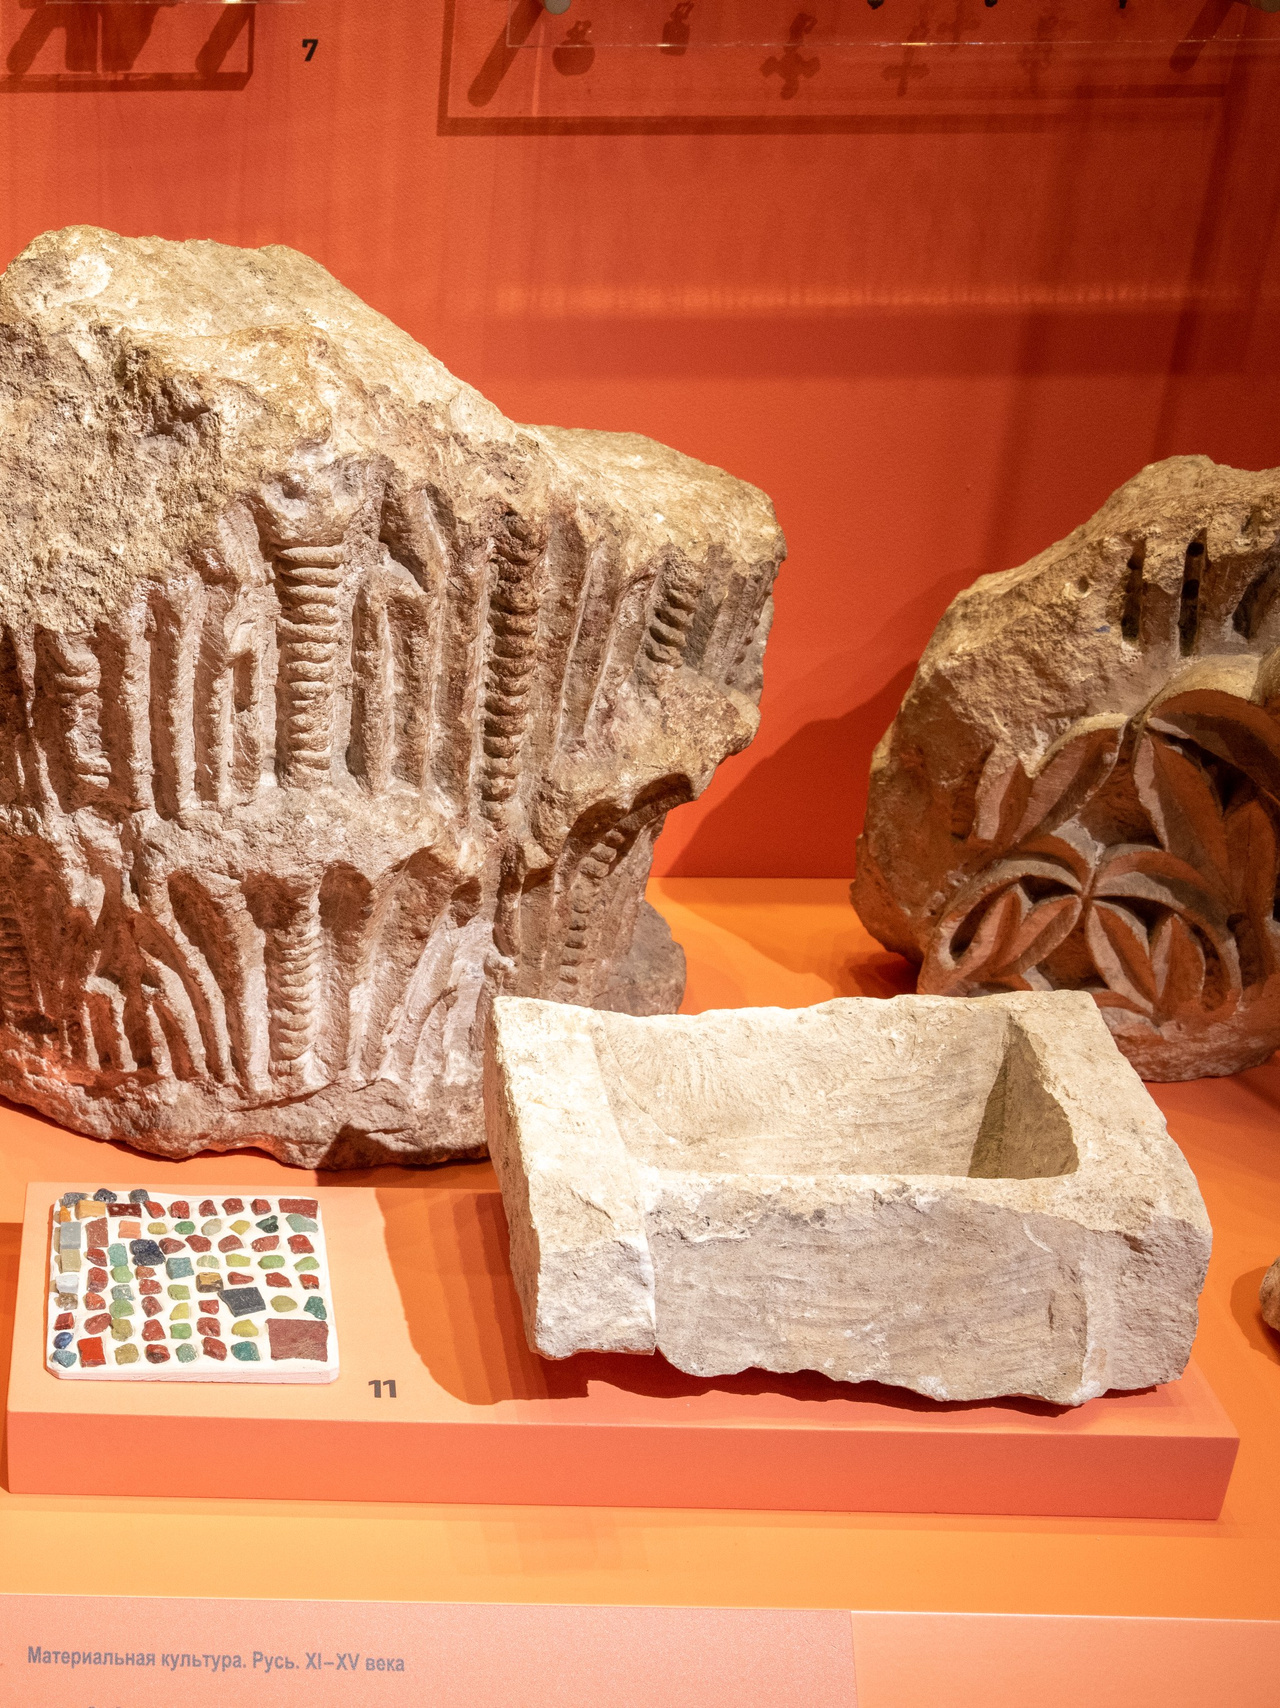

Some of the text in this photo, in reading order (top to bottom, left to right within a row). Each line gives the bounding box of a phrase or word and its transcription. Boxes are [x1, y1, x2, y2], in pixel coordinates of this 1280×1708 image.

[302, 39, 319, 62] 7
[368, 1379, 397, 1398] 11
[27, 1646, 156, 1669] Материальная
[161, 1652, 247, 1673] культура.
[253, 1651, 300, 1674] Русь.
[365, 1657, 406, 1672] века
